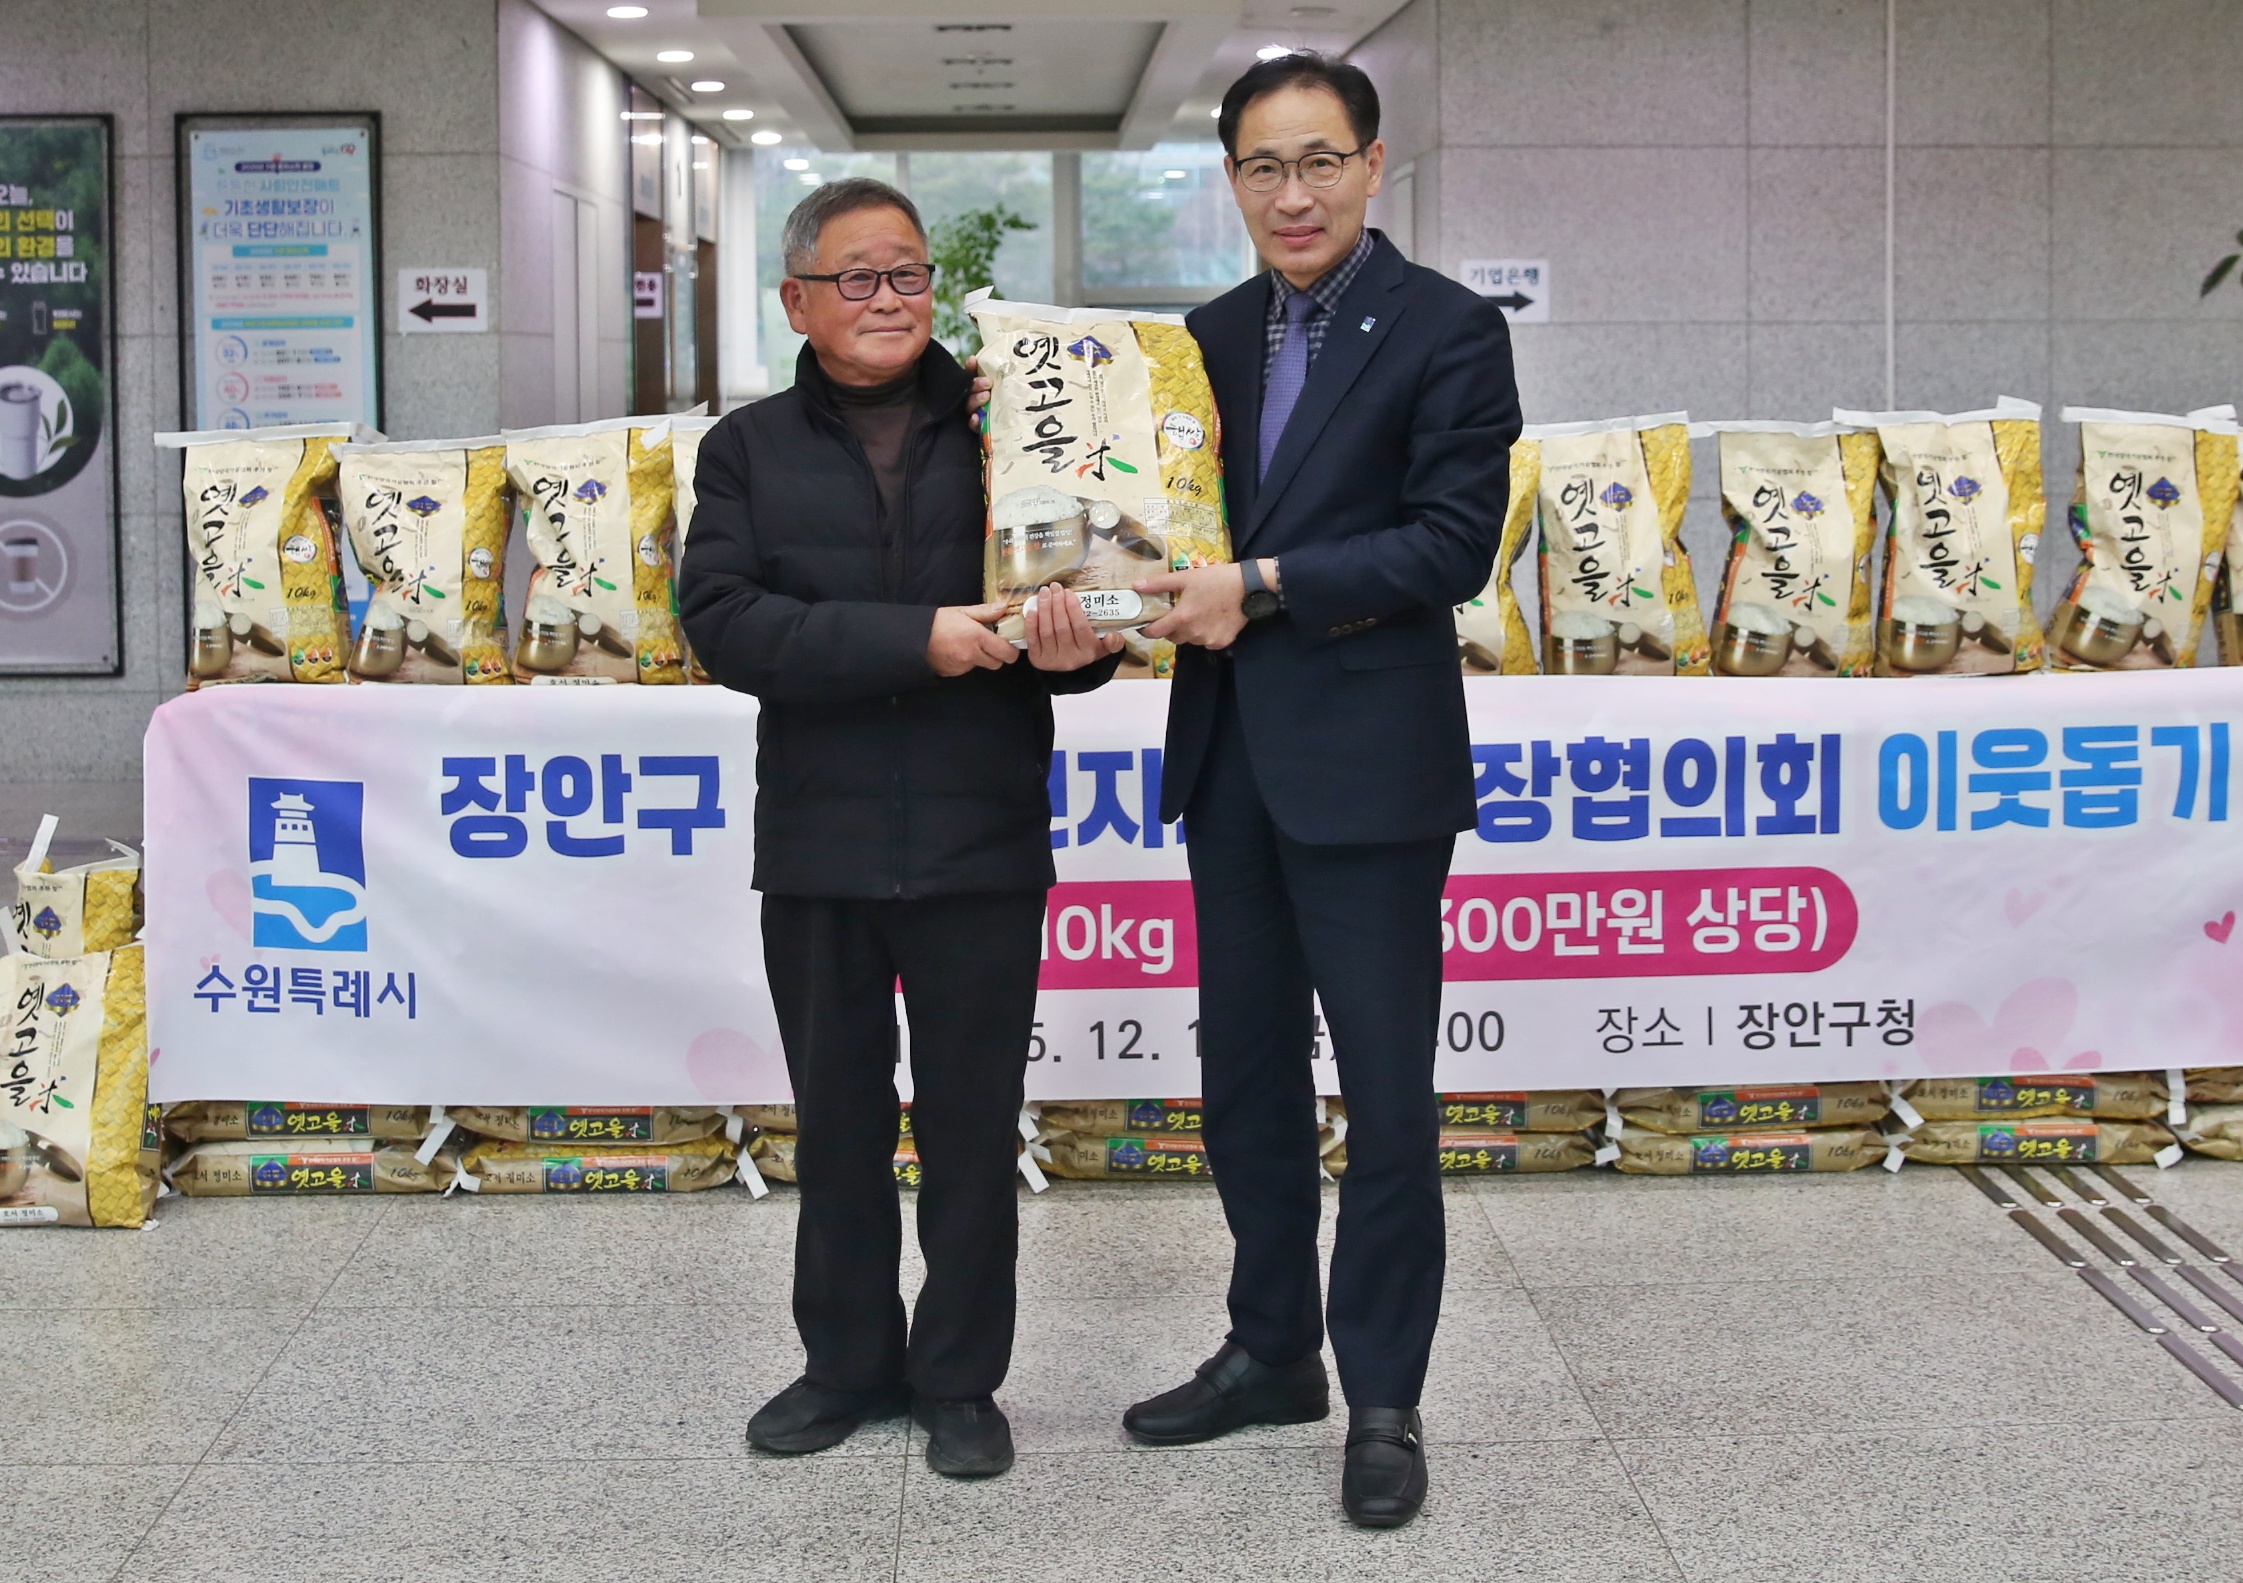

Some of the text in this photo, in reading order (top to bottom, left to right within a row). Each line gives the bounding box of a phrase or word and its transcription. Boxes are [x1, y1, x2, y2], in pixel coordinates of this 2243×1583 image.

[224, 199, 334, 216] 기초생활보장이
[17, 209, 74, 231] 선택이
[213, 221, 243, 238] 더욱
[10, 261, 88, 284] 있습니다
[1469, 266, 1540, 286] 기업은행
[415, 275, 468, 295] 화장실
[1166, 476, 1203, 497] 10kg
[1080, 593, 1120, 609] 정미소
[1877, 721, 2232, 832] 이웃돕기
[440, 753, 726, 859] 장안구
[1685, 885, 1829, 954] 상당)
[193, 963, 417, 1020] 수원특례시
[1089, 1020, 1160, 1062] 12.
[1595, 1006, 1684, 1053] 장소
[1737, 997, 1917, 1050] 장안구청
[213, 1168, 242, 1183] 정미소
